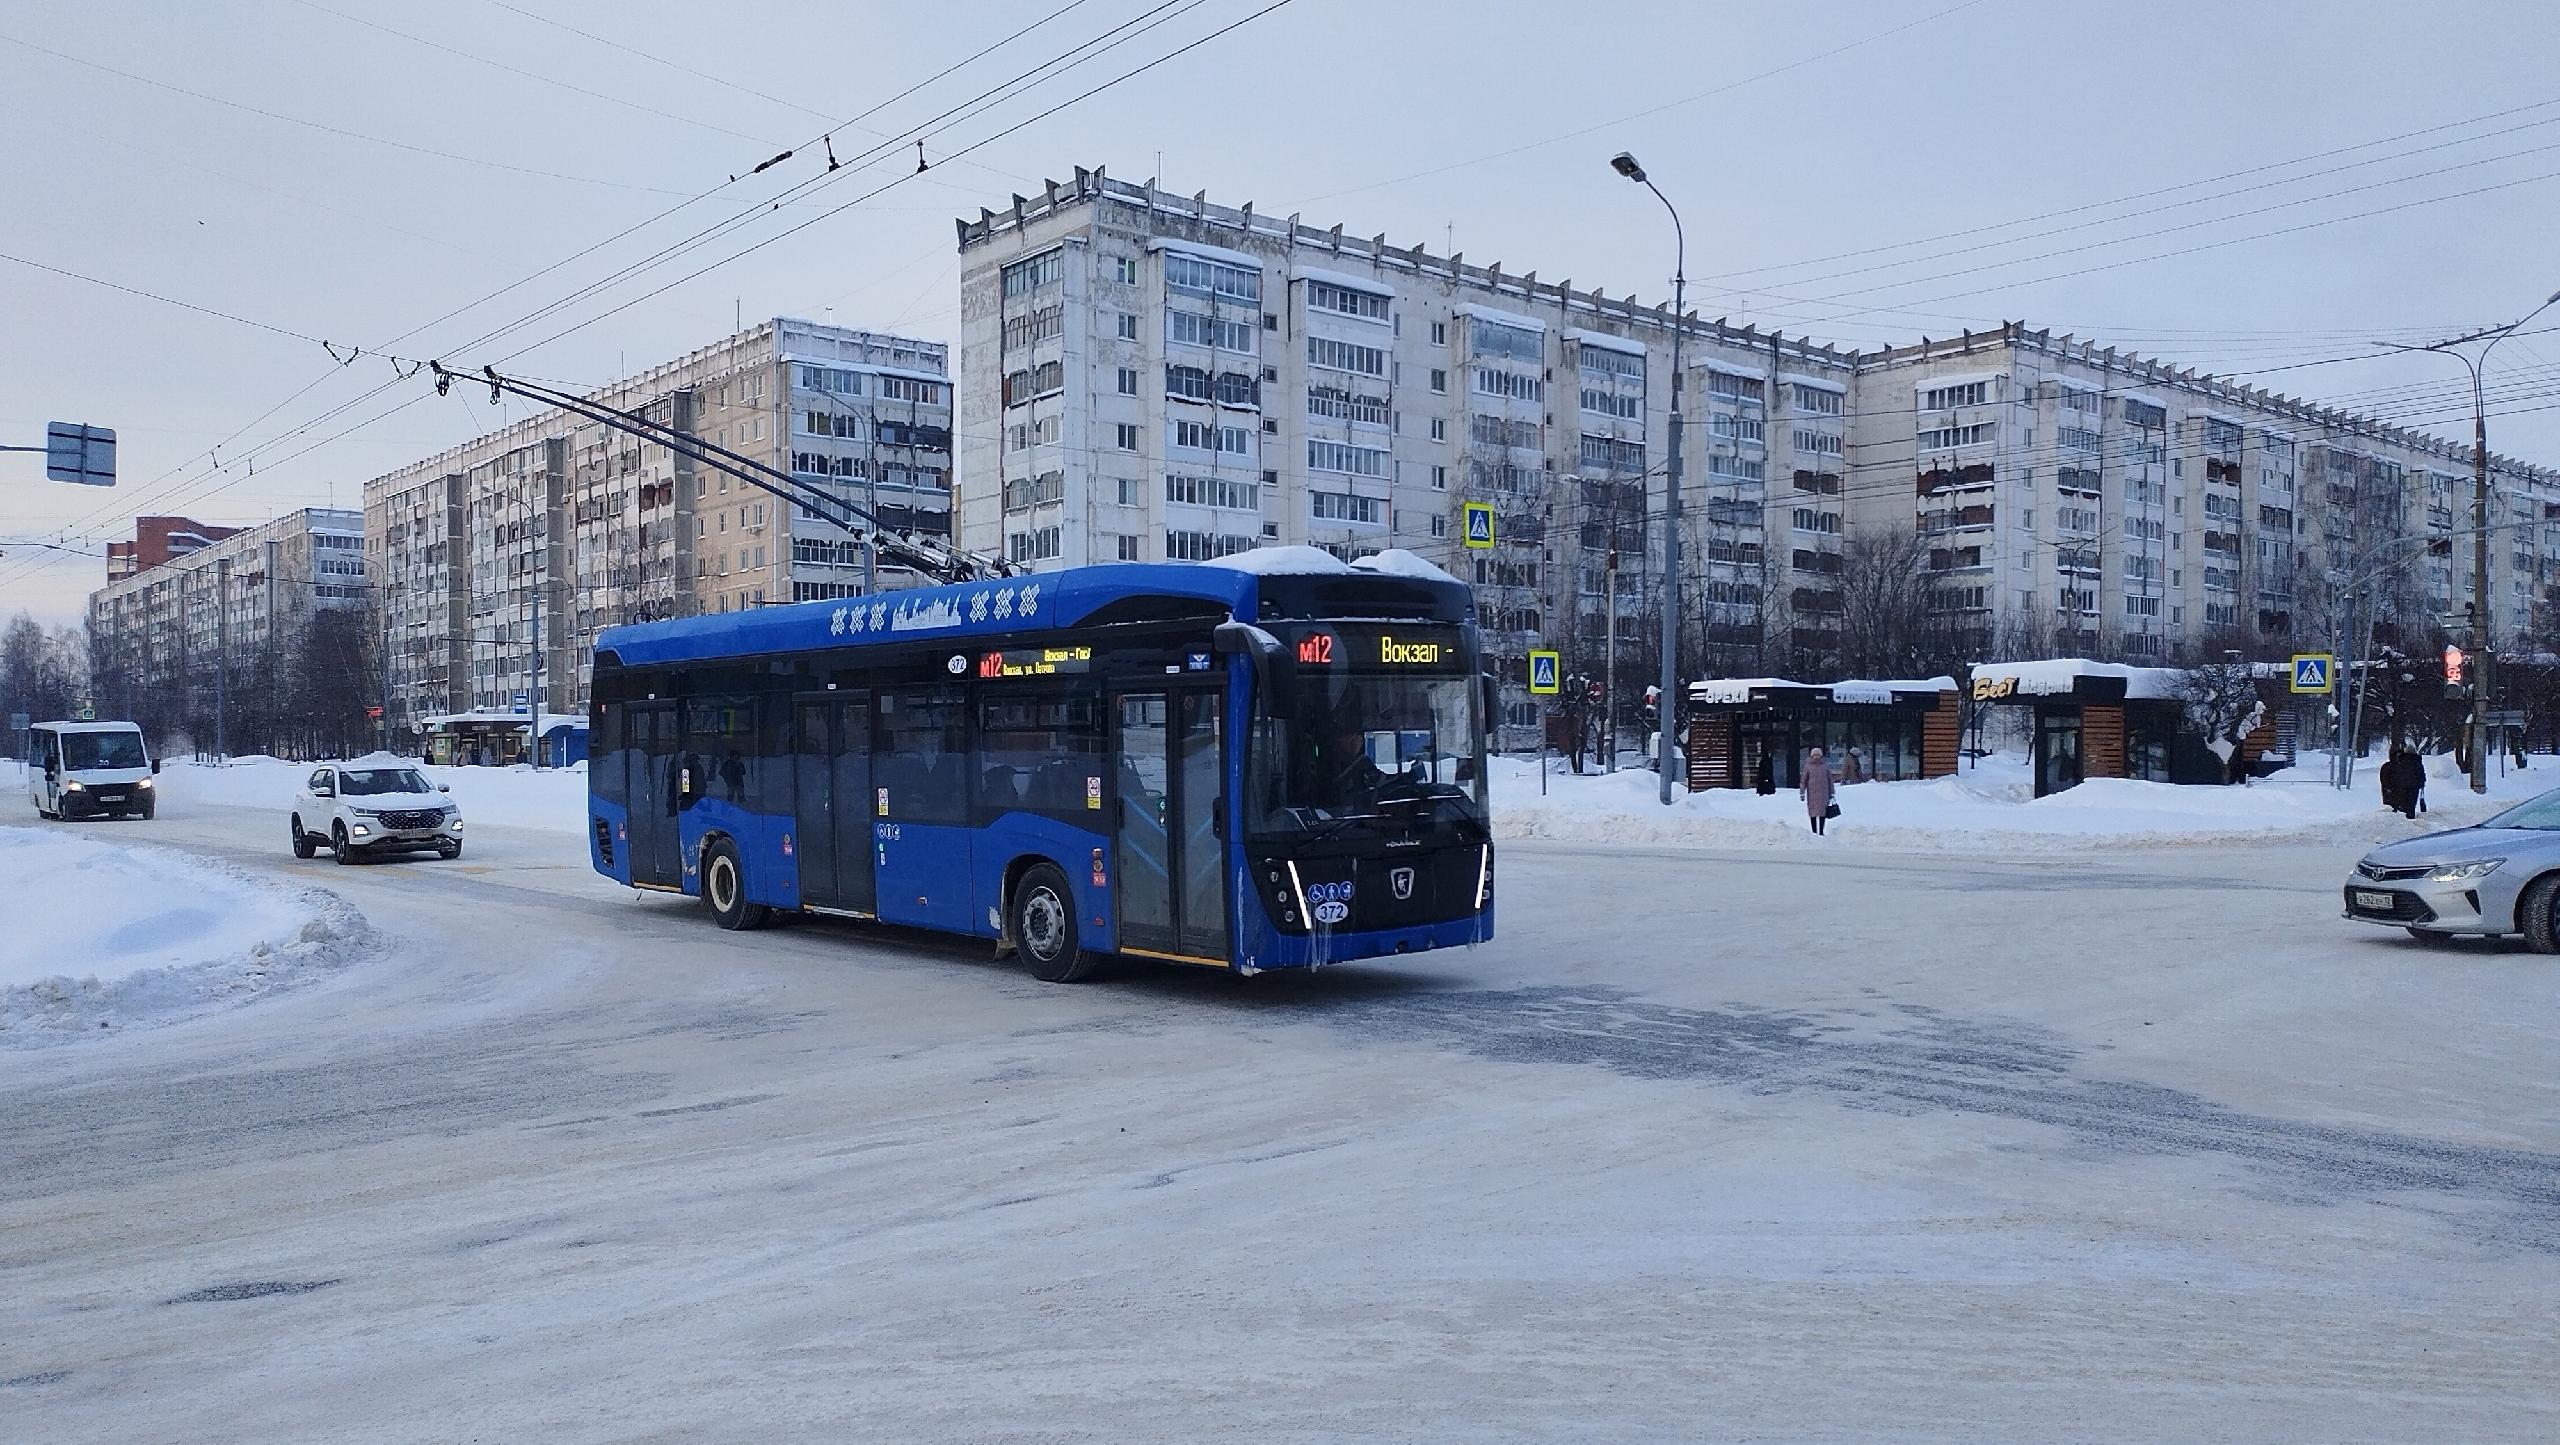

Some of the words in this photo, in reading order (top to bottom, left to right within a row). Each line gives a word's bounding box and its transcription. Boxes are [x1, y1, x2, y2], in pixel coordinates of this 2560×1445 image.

[1381, 636, 1438, 663] Вокзал
[951, 658, 965, 673] 372
[1320, 905, 1344, 920] 372
